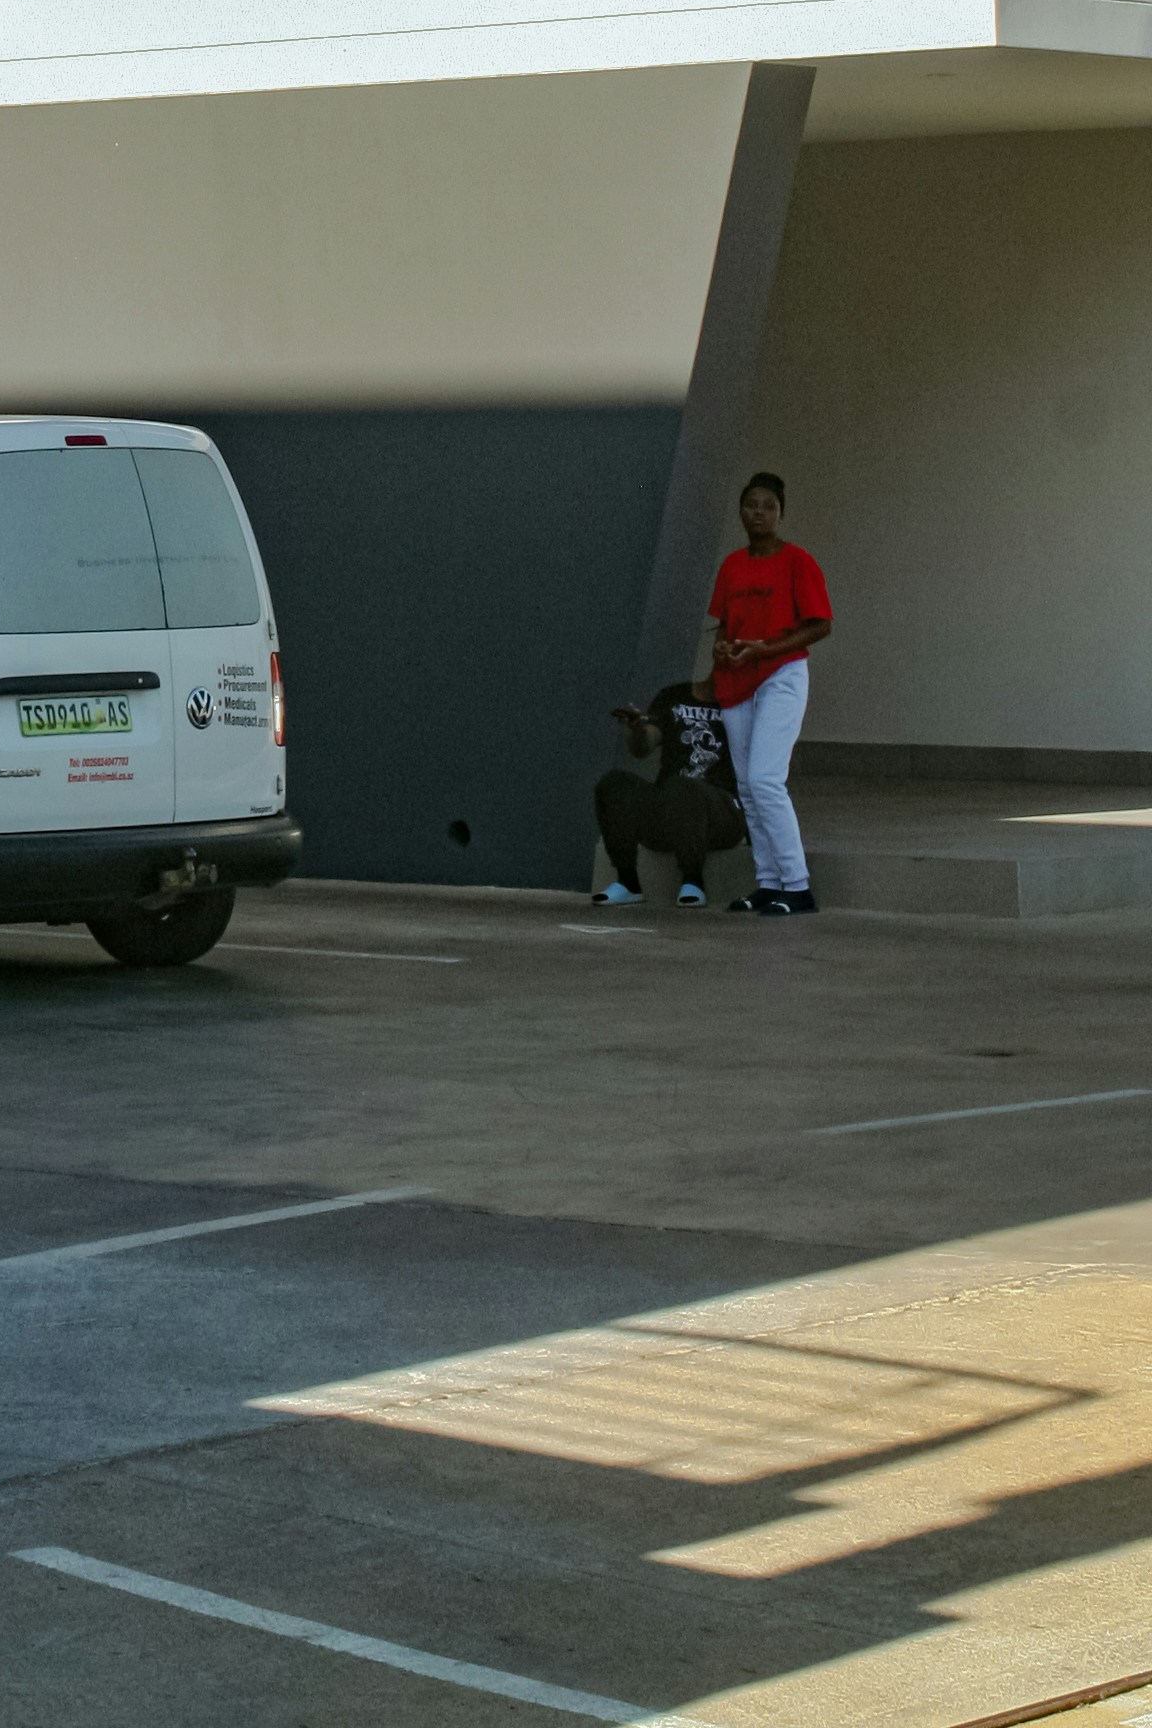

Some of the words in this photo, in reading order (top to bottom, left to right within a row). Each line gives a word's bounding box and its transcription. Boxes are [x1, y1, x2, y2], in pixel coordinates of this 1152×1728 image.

[222, 663, 255, 679] Logistics
[223, 678, 267, 692] Procurement
[224, 696, 257, 711] Medicals
[107, 701, 129, 727] AS
[672, 704, 723, 721] MINN
